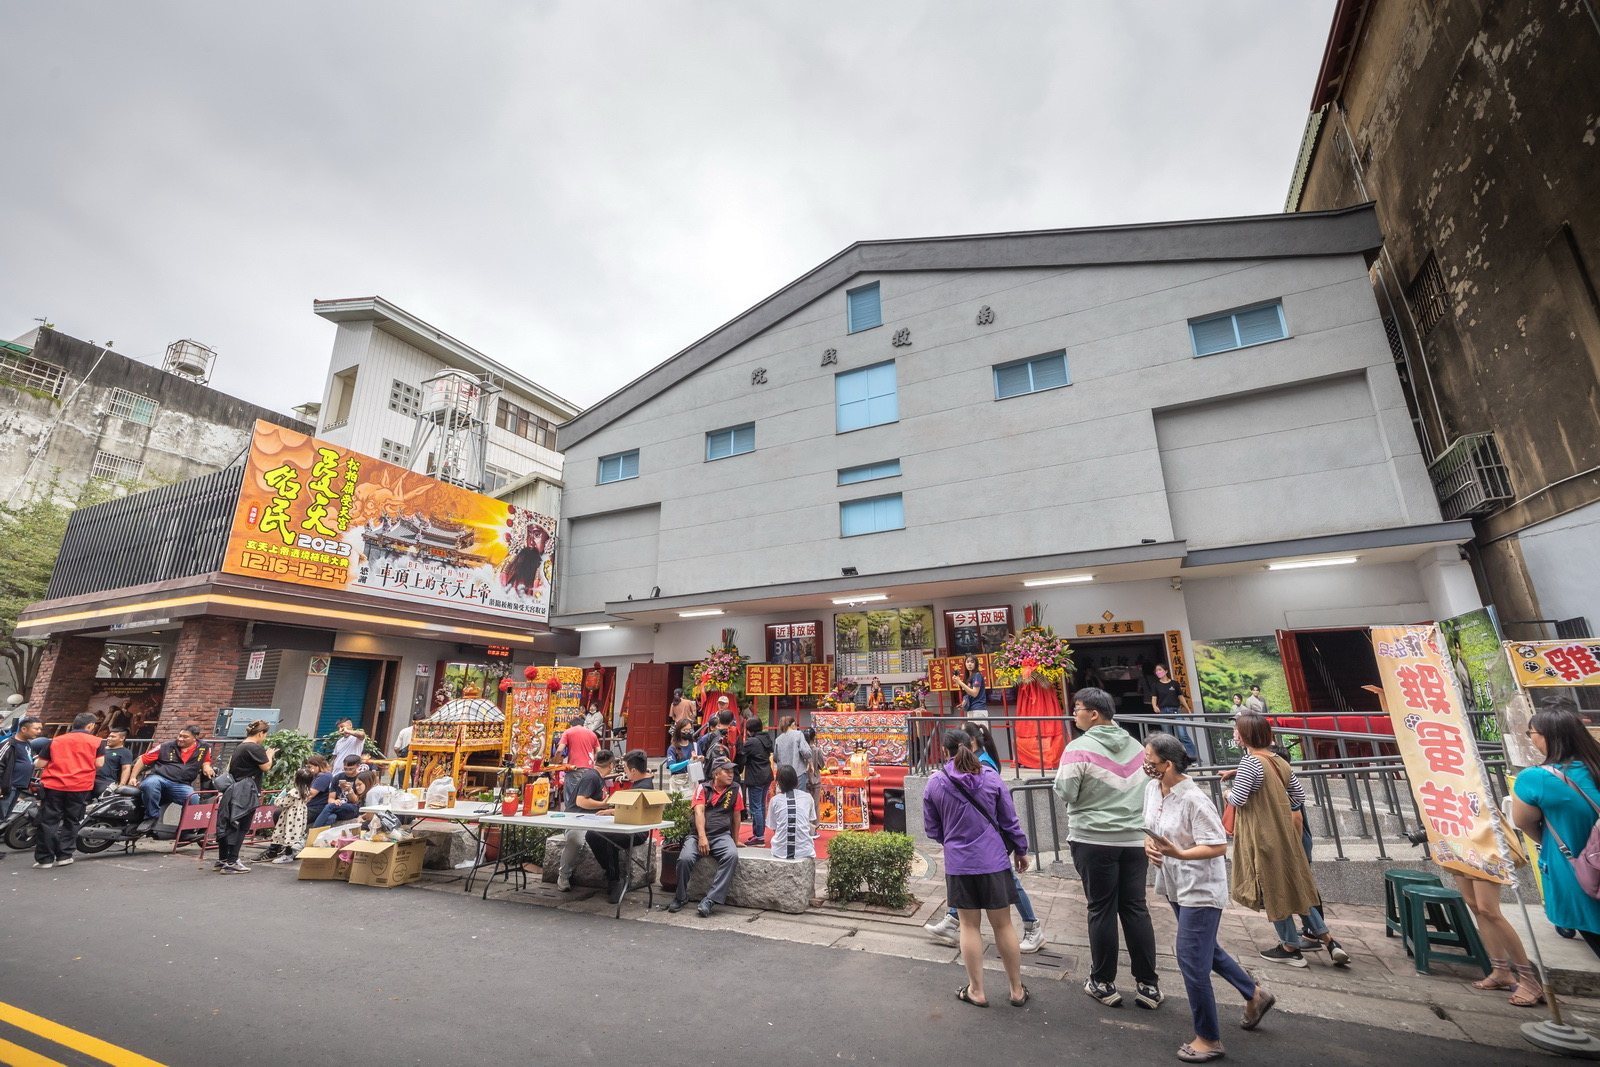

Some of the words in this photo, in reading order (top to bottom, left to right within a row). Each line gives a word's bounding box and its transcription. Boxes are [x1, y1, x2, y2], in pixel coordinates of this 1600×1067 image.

[337, 457, 361, 531] 松柏嶺受天宮
[297, 533, 352, 557] 2023
[240, 551, 347, 584] 12.16-12.24
[408, 561, 419, 570] BE
[424, 564, 453, 577] WITH
[459, 572, 471, 580] ME
[376, 563, 491, 605] 車頂上的玄天上帝
[955, 611, 1005, 625] 今天放映
[777, 624, 815, 638] 近期放映
[750, 667, 763, 693] 風調雨順
[769, 667, 782, 693] 國泰民安
[254, 810, 272, 821] 停車
